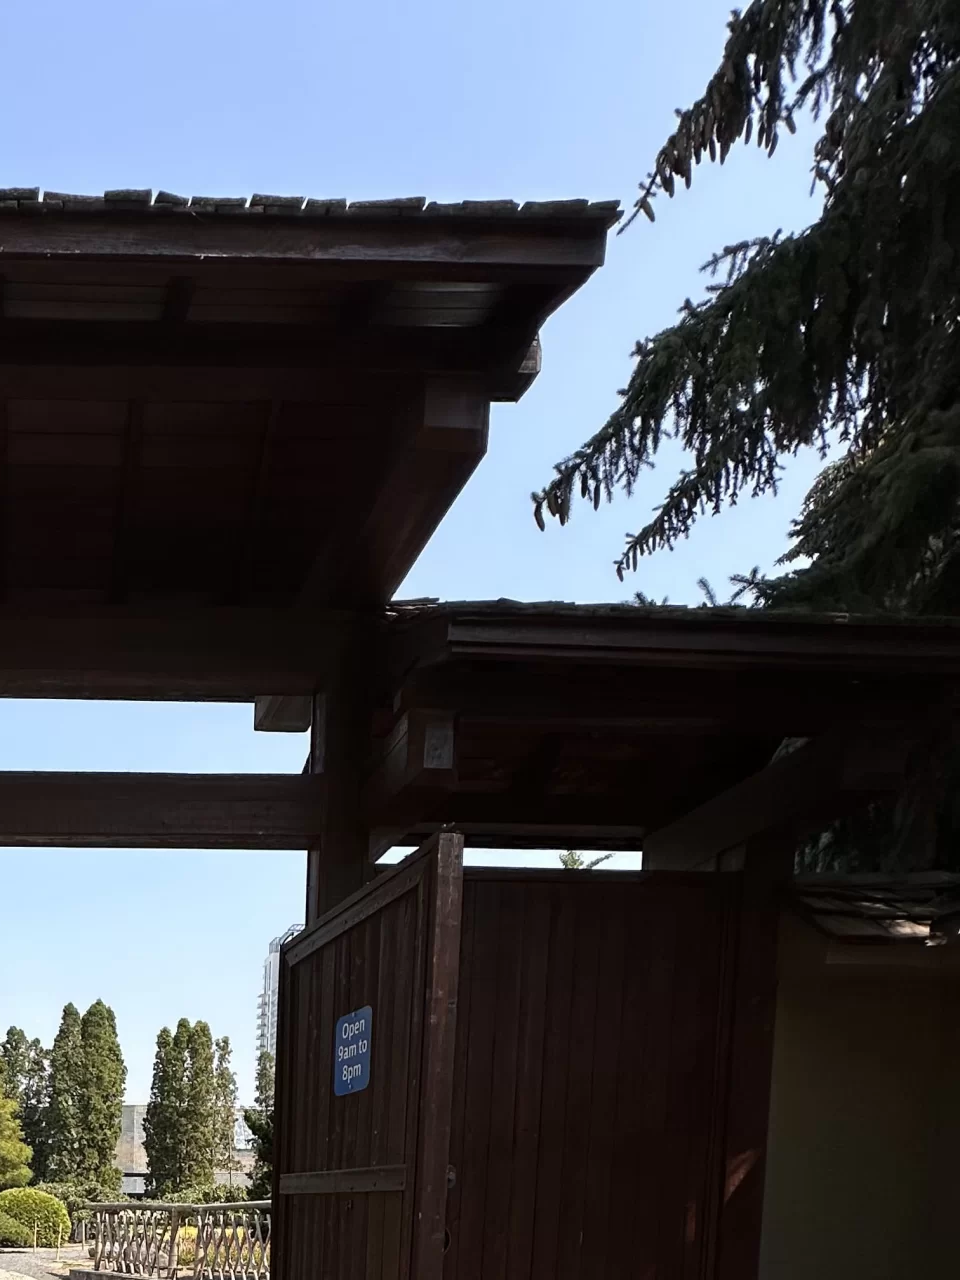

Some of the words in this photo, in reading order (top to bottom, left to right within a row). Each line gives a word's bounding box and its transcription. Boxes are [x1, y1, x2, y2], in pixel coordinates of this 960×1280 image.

[342, 1019, 365, 1040] Open
[338, 1044, 356, 1061] 9am
[359, 1039, 368, 1054] to
[342, 1064, 361, 1083] 8pm
